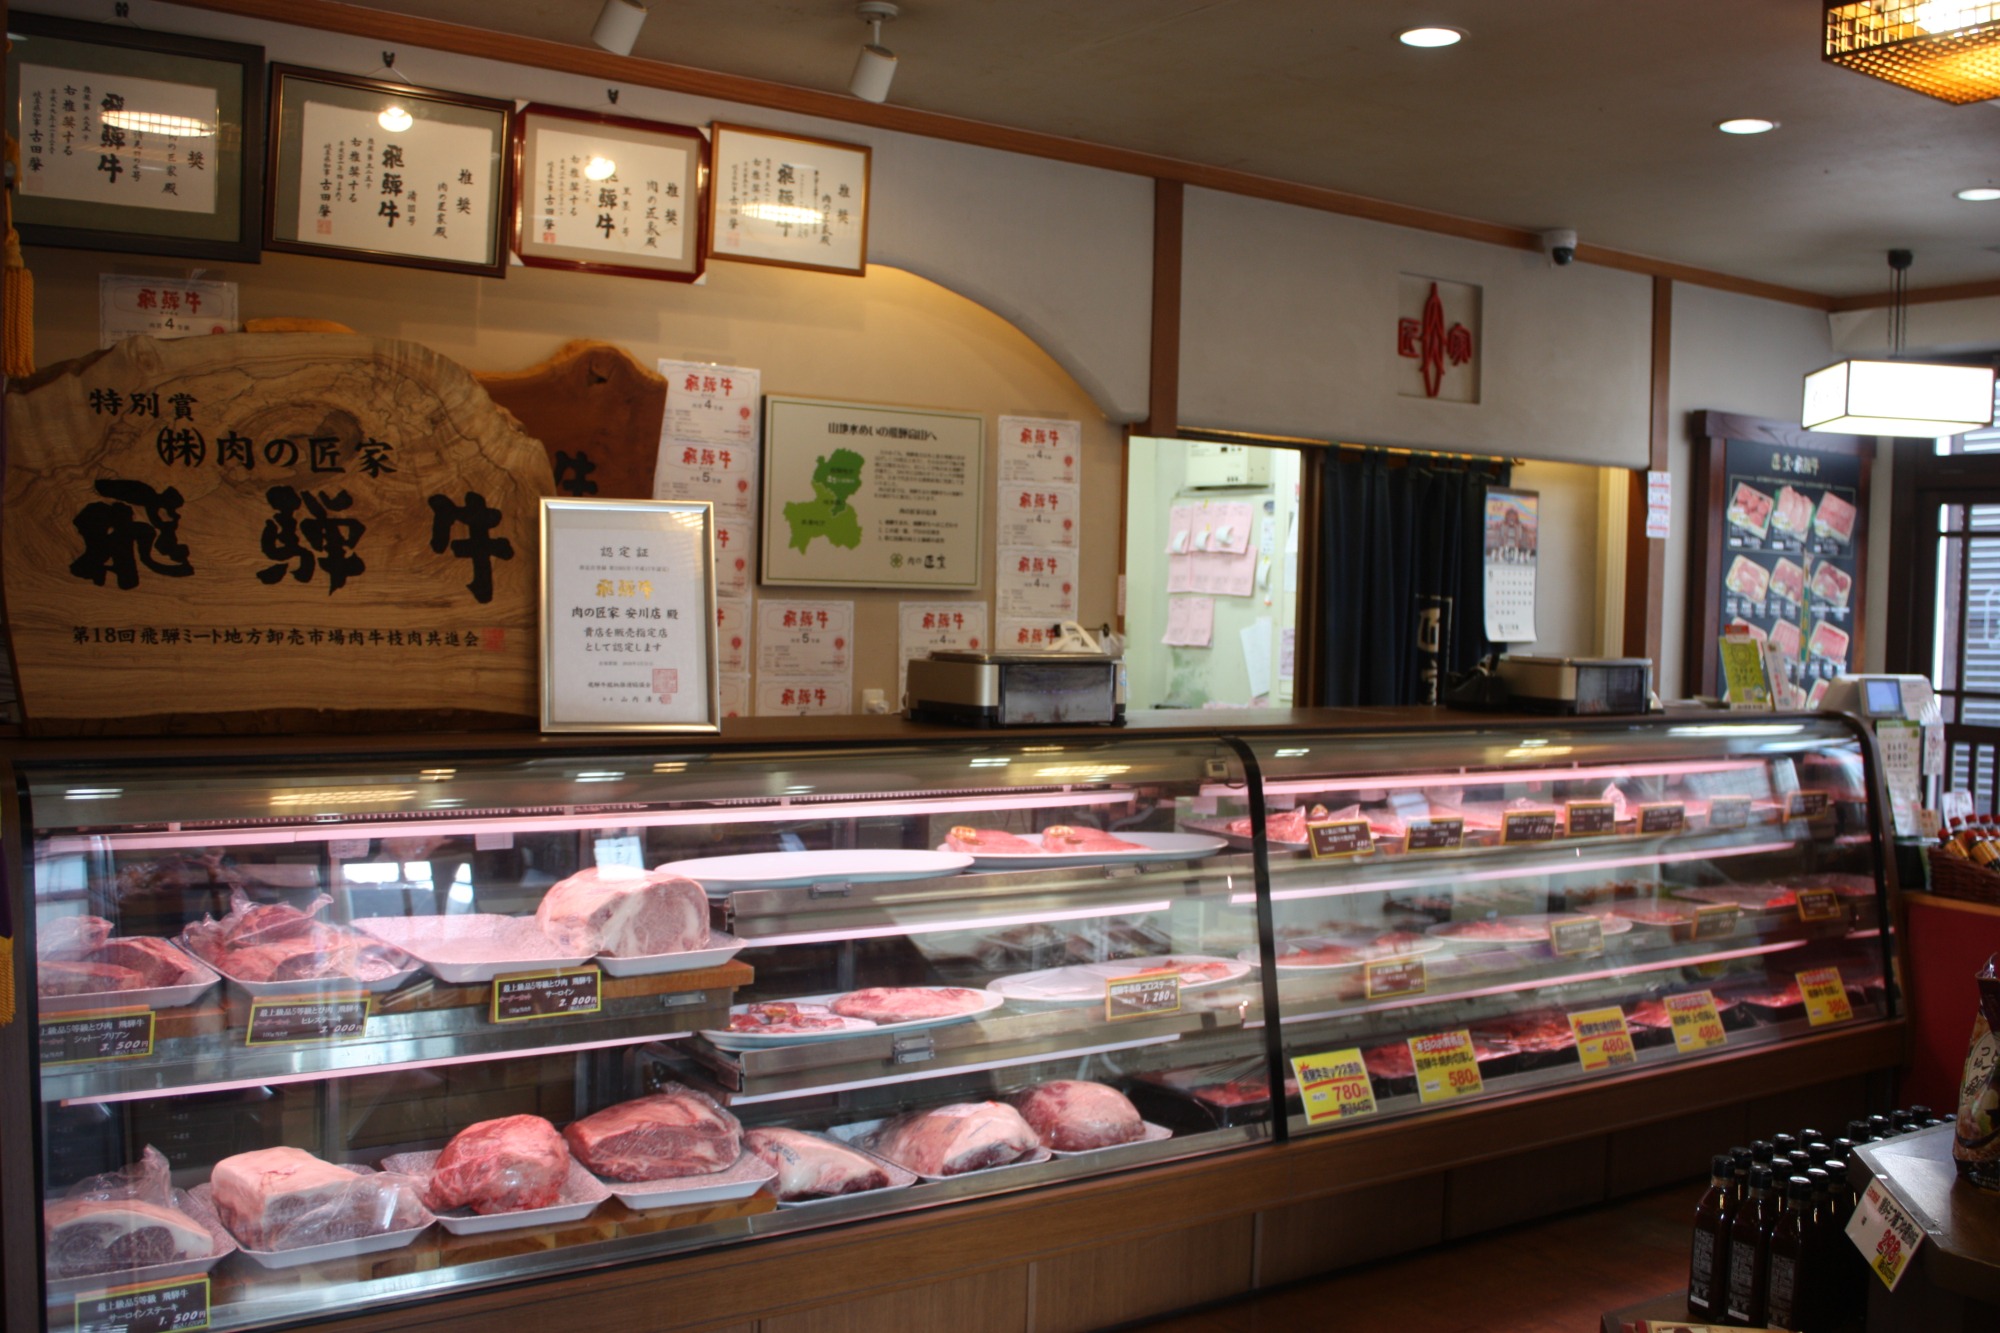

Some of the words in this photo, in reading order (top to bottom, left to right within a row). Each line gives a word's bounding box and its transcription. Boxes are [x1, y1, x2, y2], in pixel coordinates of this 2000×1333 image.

[378, 143, 406, 229] 飛騨牛
[136, 287, 203, 315] 飛騨牛
[684, 373, 734, 398] 飛騨牛
[89, 388, 199, 422] 特別賞
[1019, 427, 1060, 448] 飛騨牛
[681, 446, 732, 470] 飛騨牛
[1018, 492, 1059, 511] 飛騨牛
[69, 478, 515, 604] 飛騨牛
[600, 545, 649, 559] 認定証
[1017, 556, 1058, 575] 飛騨牛
[595, 578, 655, 600] 飛騨牛
[571, 606, 620, 620] 肉の匠家
[624, 606, 662, 620] 安川店
[666, 607, 680, 620] 殿
[782, 609, 829, 629] 飛騨牛
[921, 611, 965, 631] 飛騨牛
[583, 626, 669, 639] 貴店を販売指定店
[585, 641, 663, 653] として認定します
[780, 688, 827, 708] 飛騨牛
[502, 978, 569, 993] 最上級品5等級とび肉
[571, 975, 594, 986] 飛騨牛
[545, 988, 576, 999] サーロイン
[300, 1015, 344, 1025] ヒレステーキ
[73, 1031, 131, 1044] シャトーブリアン
[162, 1288, 190, 1302] 飛騨牛
[109, 1302, 179, 1322] サーロインステーキ
